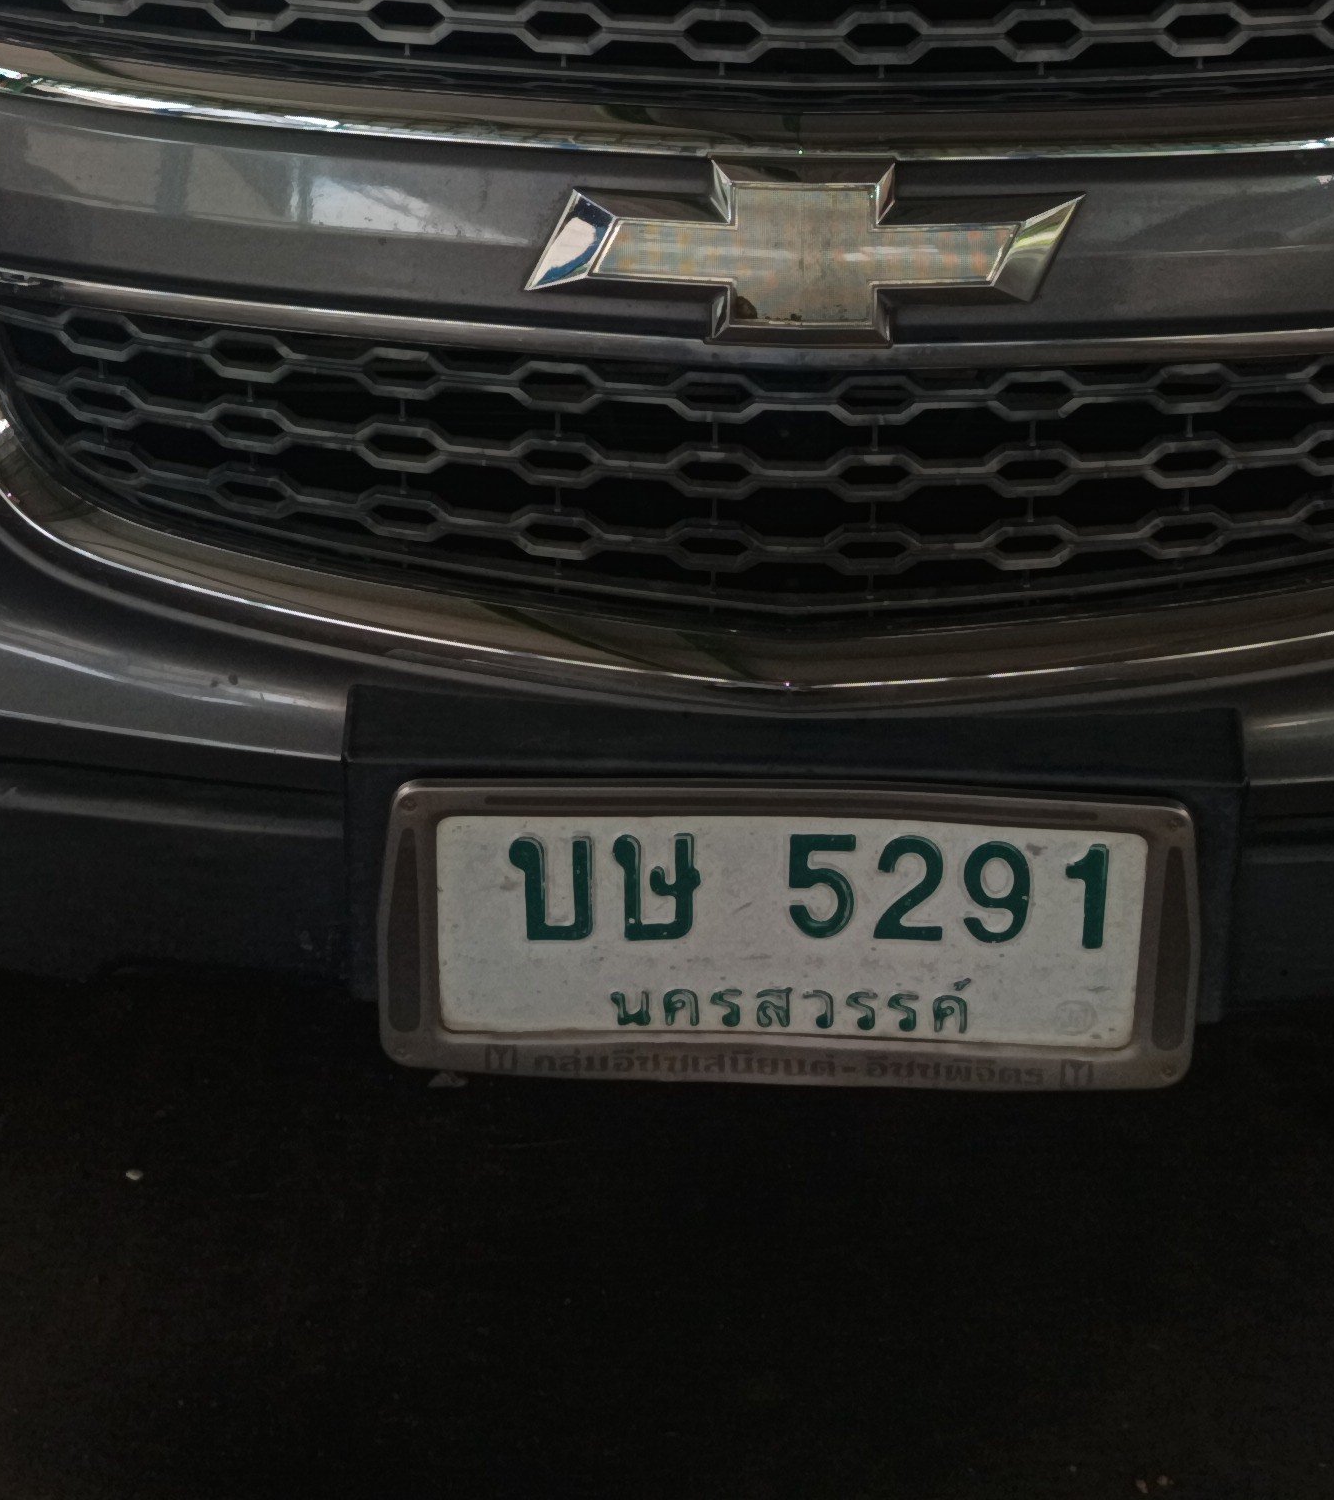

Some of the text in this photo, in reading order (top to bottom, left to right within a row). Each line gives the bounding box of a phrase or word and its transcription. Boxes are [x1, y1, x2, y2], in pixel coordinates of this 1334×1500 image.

[508, 832, 1110, 950] บษ 5291
[611, 977, 971, 1034] นครสวรรค์
